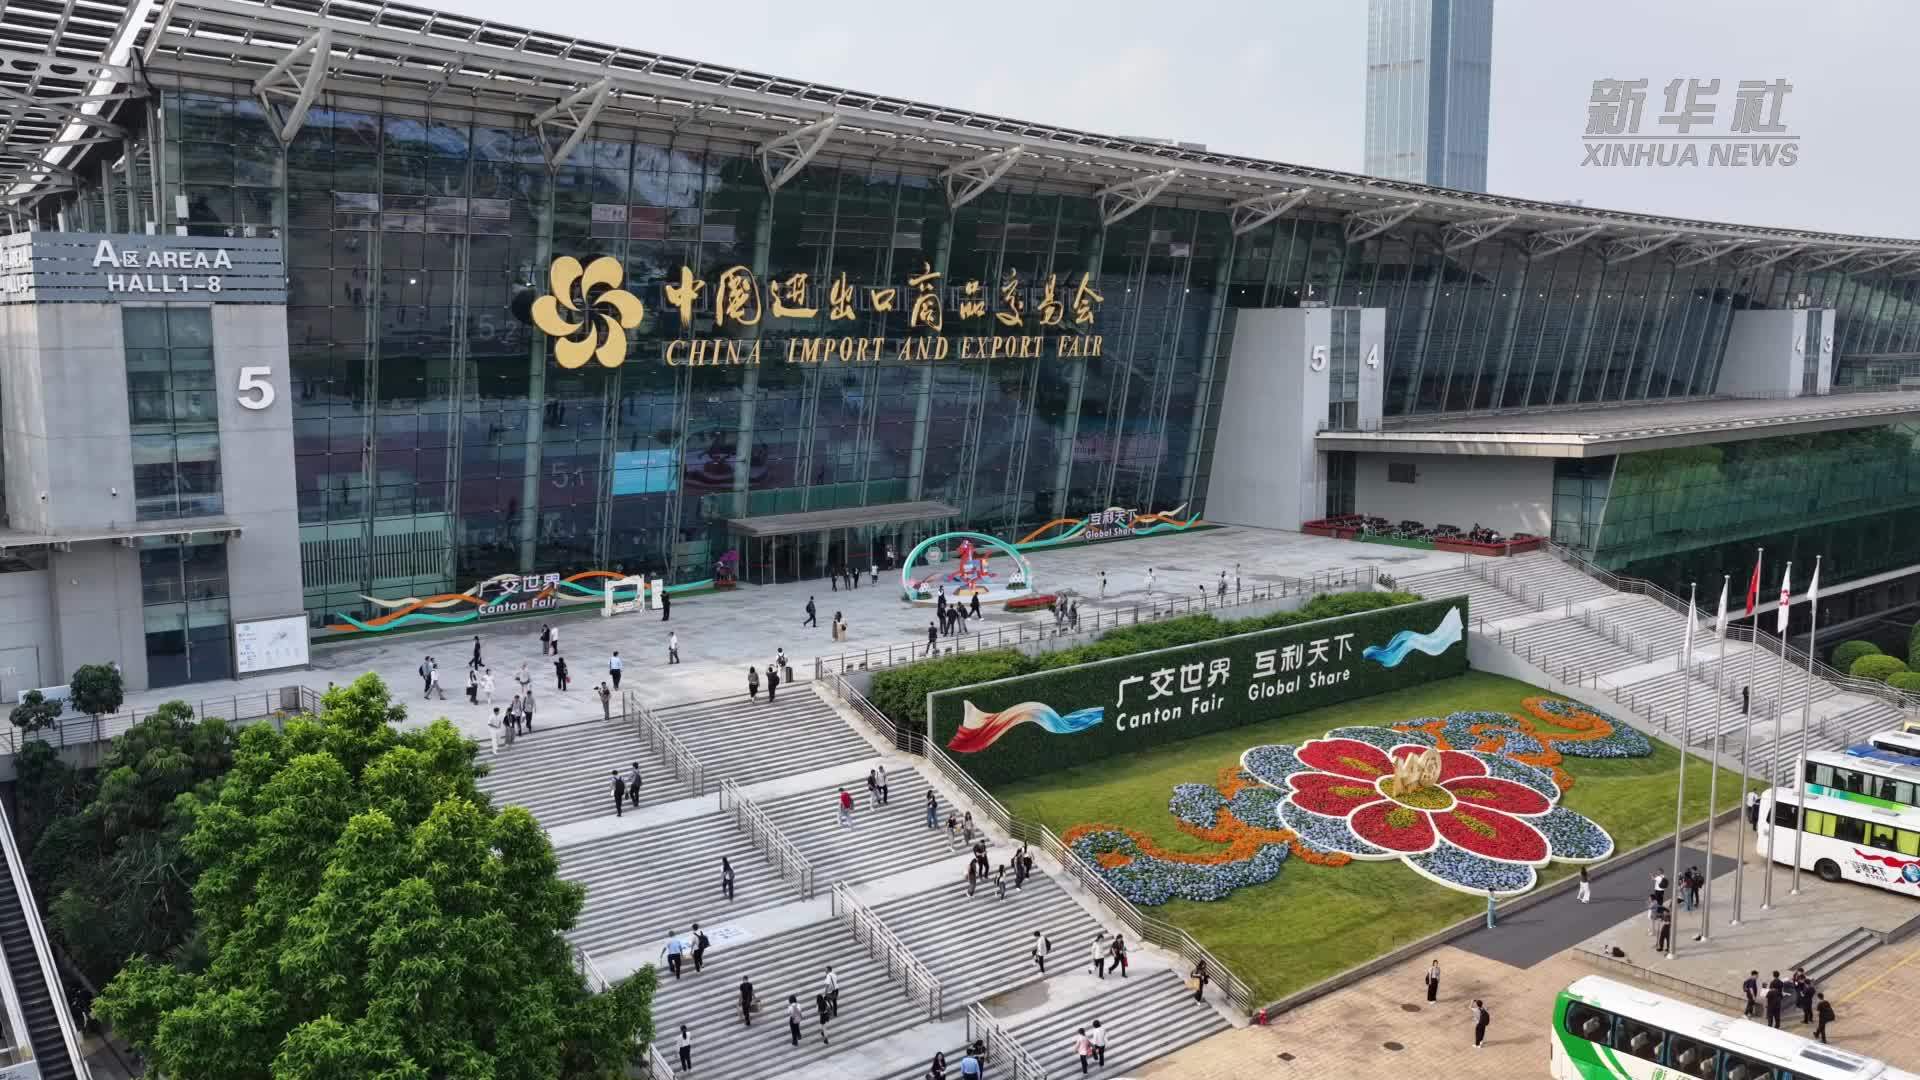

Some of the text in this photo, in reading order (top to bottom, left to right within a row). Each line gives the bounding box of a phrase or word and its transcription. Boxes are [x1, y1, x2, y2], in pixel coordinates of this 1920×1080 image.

[146, 251, 209, 269] AREA
[666, 334, 1104, 367] CHINA IMPORT AND EXPORT FAIR
[1366, 343, 1379, 369] 4
[1824, 335, 1833, 353] 3
[1311, 344, 1328, 372] 5
[237, 366, 275, 410] 5
[1091, 508, 1138, 526] 互利天下
[1086, 526, 1137, 540] Global Share
[478, 572, 560, 598] 广交世界
[478, 598, 558, 615] Canton Fair
[1116, 633, 1355, 708] 广交世界 互利天下
[1116, 669, 1351, 731] Canton Fair Global Share
